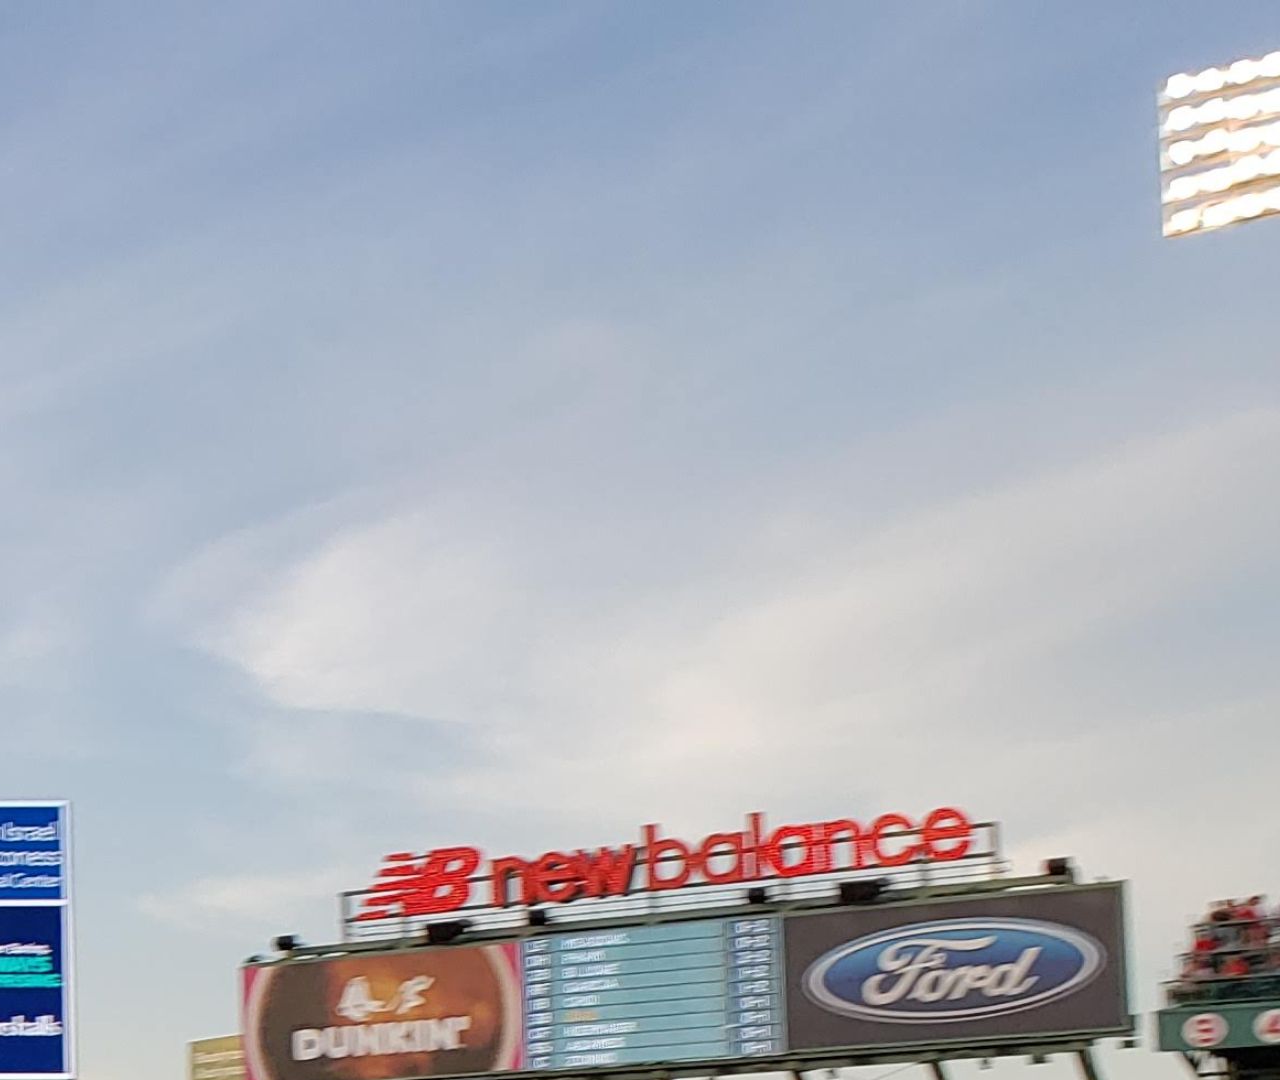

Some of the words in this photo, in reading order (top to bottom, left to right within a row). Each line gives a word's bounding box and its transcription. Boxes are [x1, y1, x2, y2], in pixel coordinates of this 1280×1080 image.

[641, 807, 973, 891] balance
[862, 934, 1042, 1006] Ford
[292, 1015, 471, 1061] DUNKIN'
